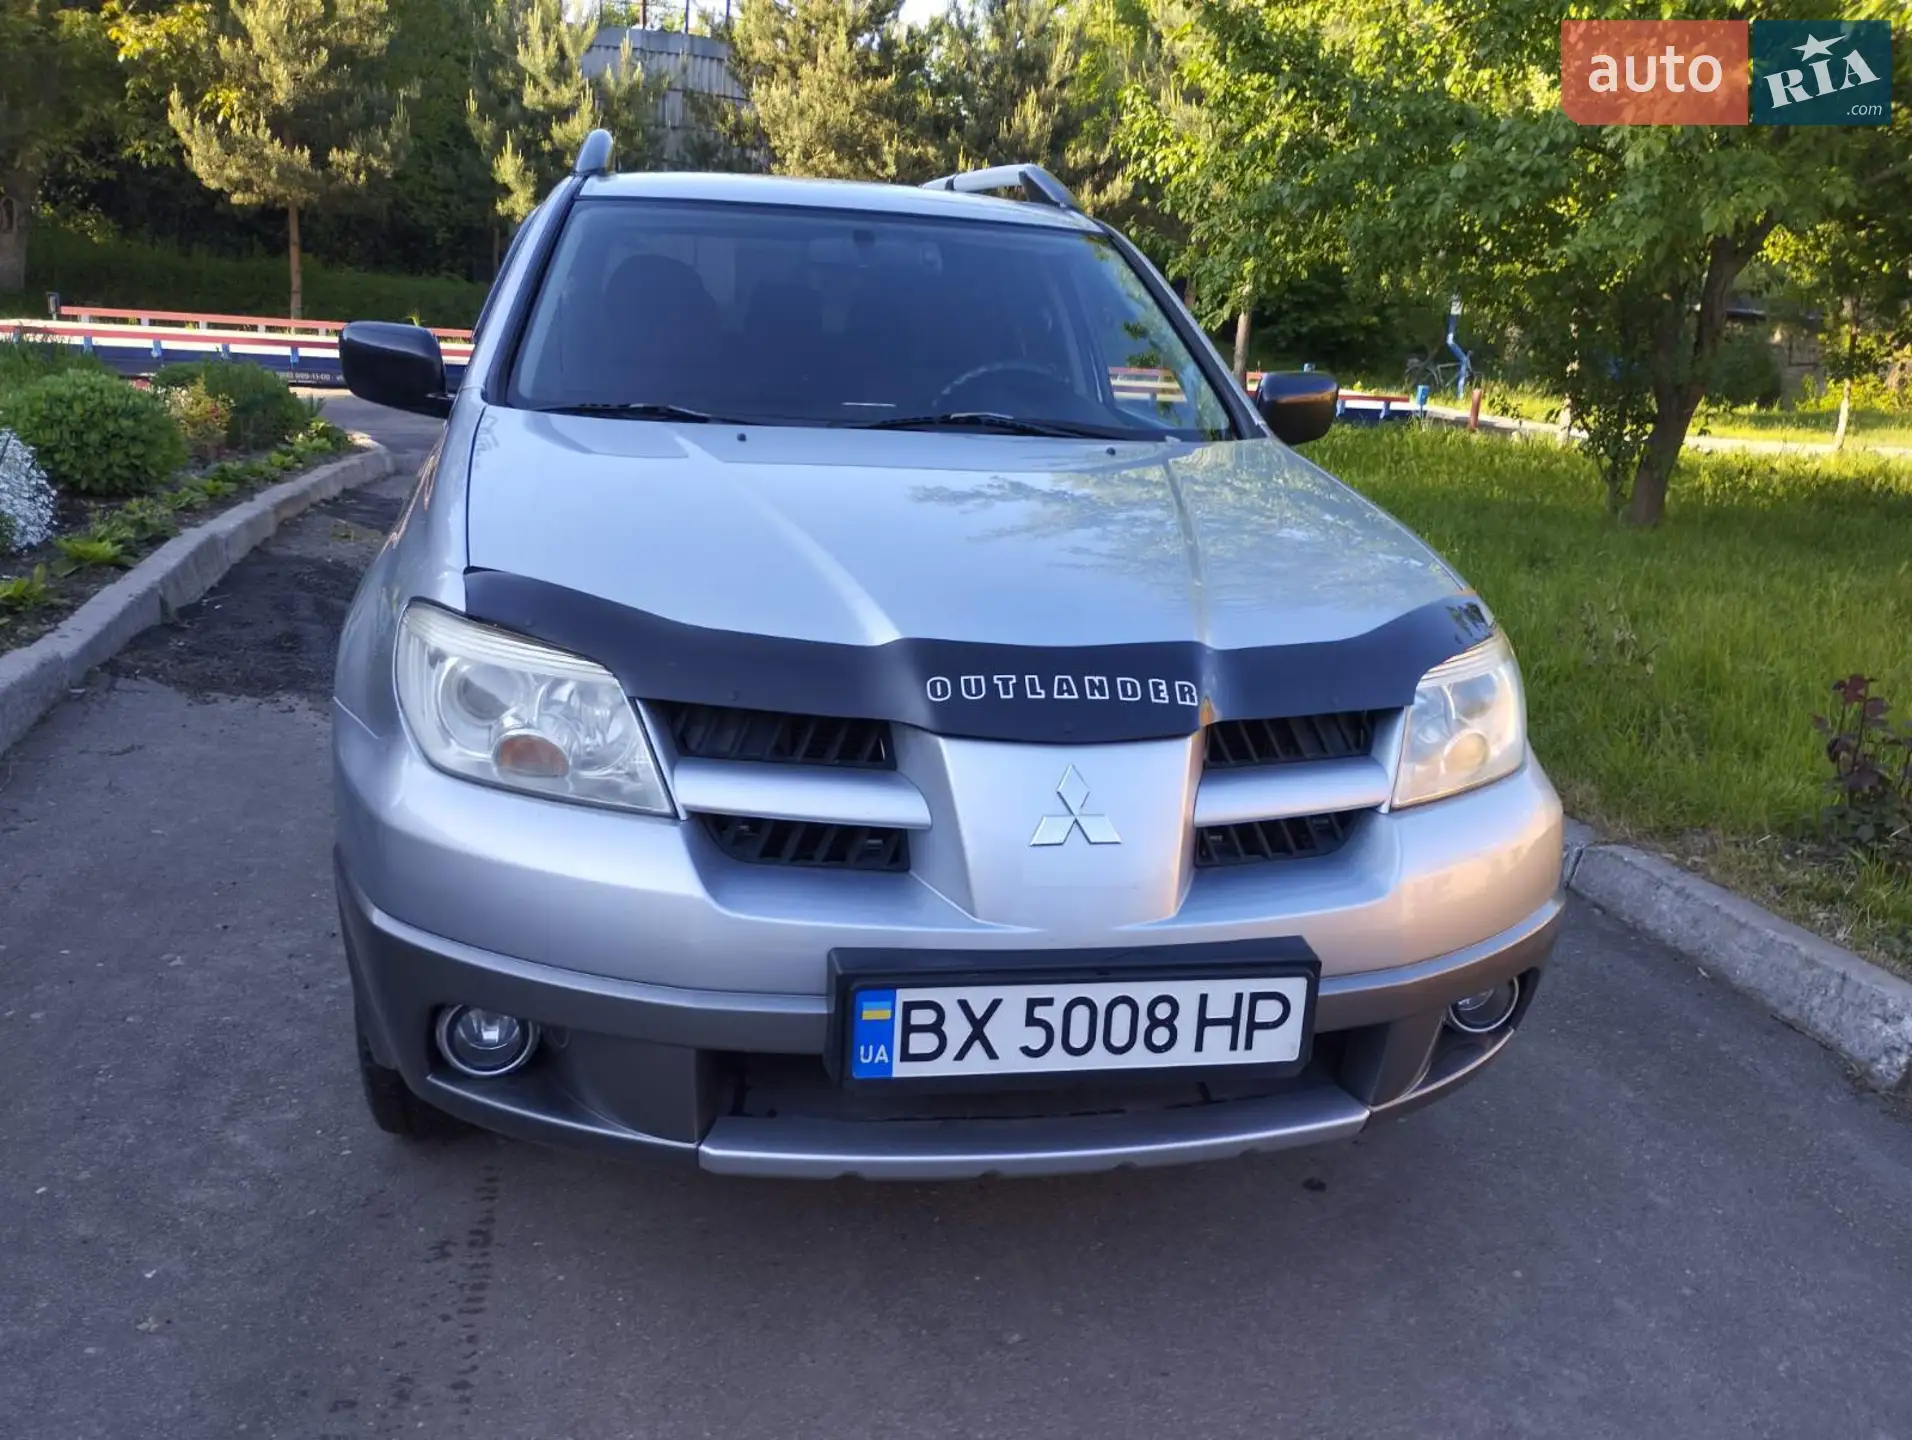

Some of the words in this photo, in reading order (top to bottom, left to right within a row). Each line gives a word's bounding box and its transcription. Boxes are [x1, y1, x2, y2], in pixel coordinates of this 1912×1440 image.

[926, 675, 1199, 706] OUTLANDER
[899, 998, 1003, 1063] BX
[1018, 993, 1180, 1058] 5008
[1193, 991, 1293, 1053] HP
[860, 1045, 889, 1064] UA
